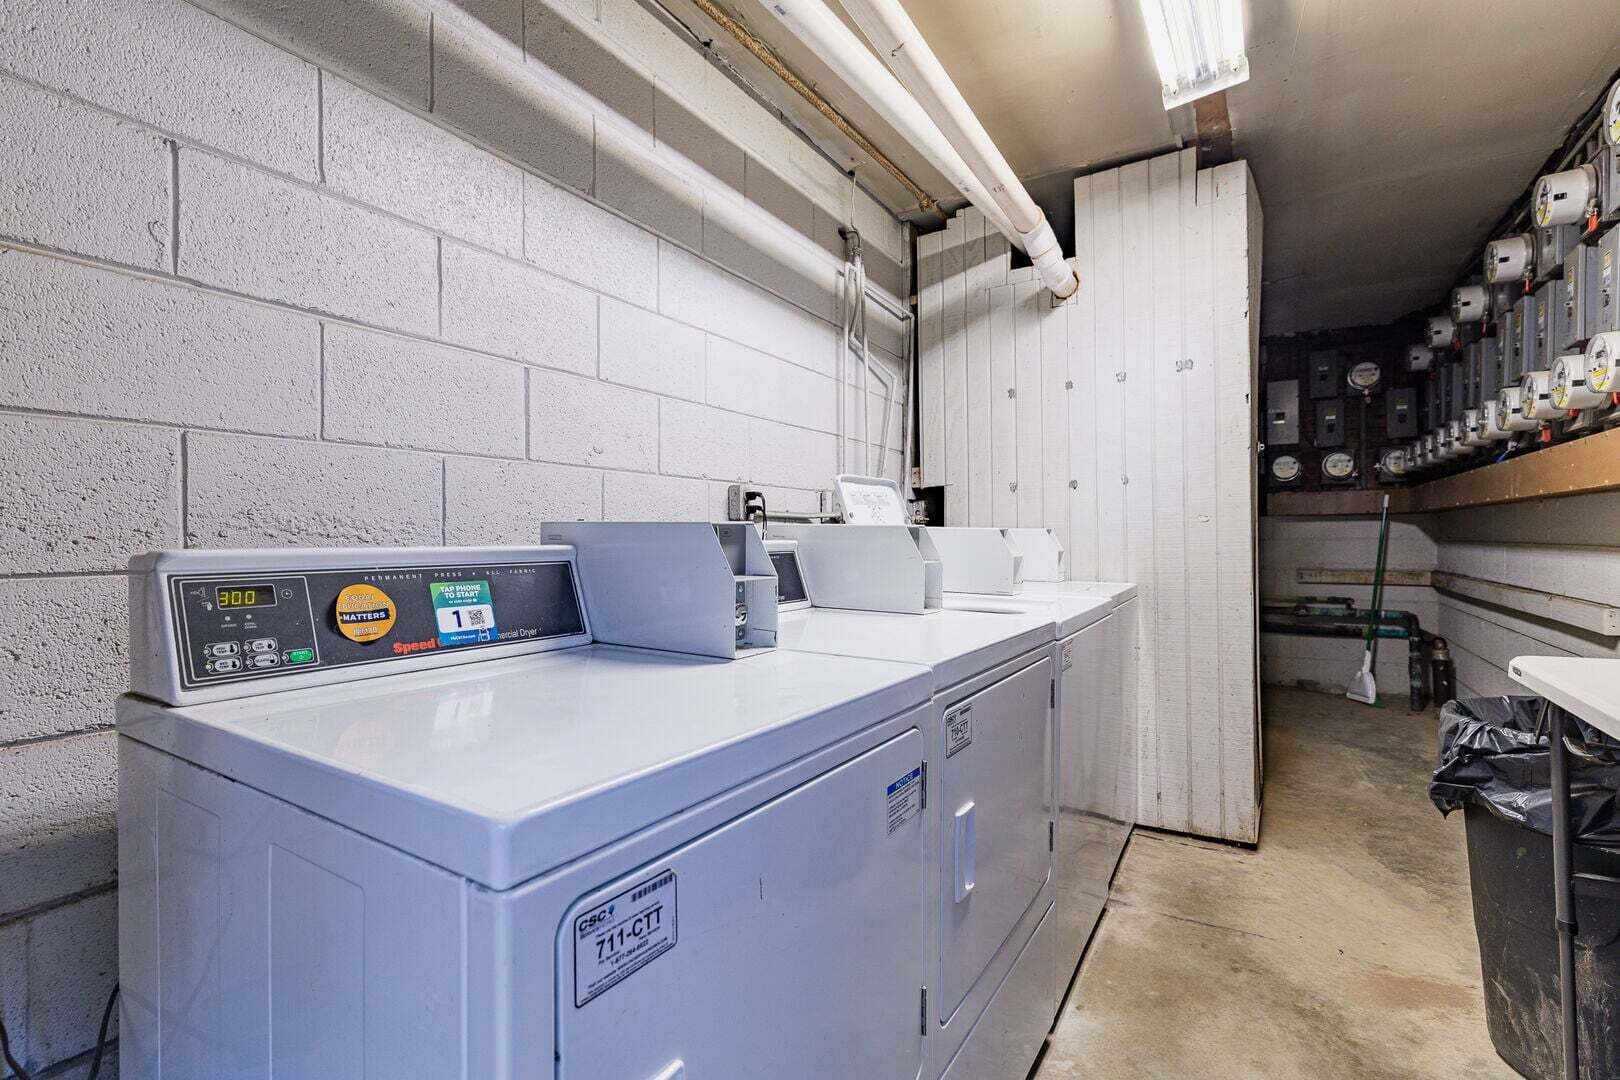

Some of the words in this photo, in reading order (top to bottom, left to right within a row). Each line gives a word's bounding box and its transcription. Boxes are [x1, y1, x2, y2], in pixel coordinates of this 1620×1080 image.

[456, 584, 481, 592] PHONE
[219, 590, 255, 606] 300
[342, 612, 386, 621] MATTERS
[452, 609, 462, 628] 1
[393, 637, 436, 655] Speed
[519, 627, 537, 637] Dryer
[578, 909, 607, 932] CSC
[596, 904, 663, 959] 711-CTT
